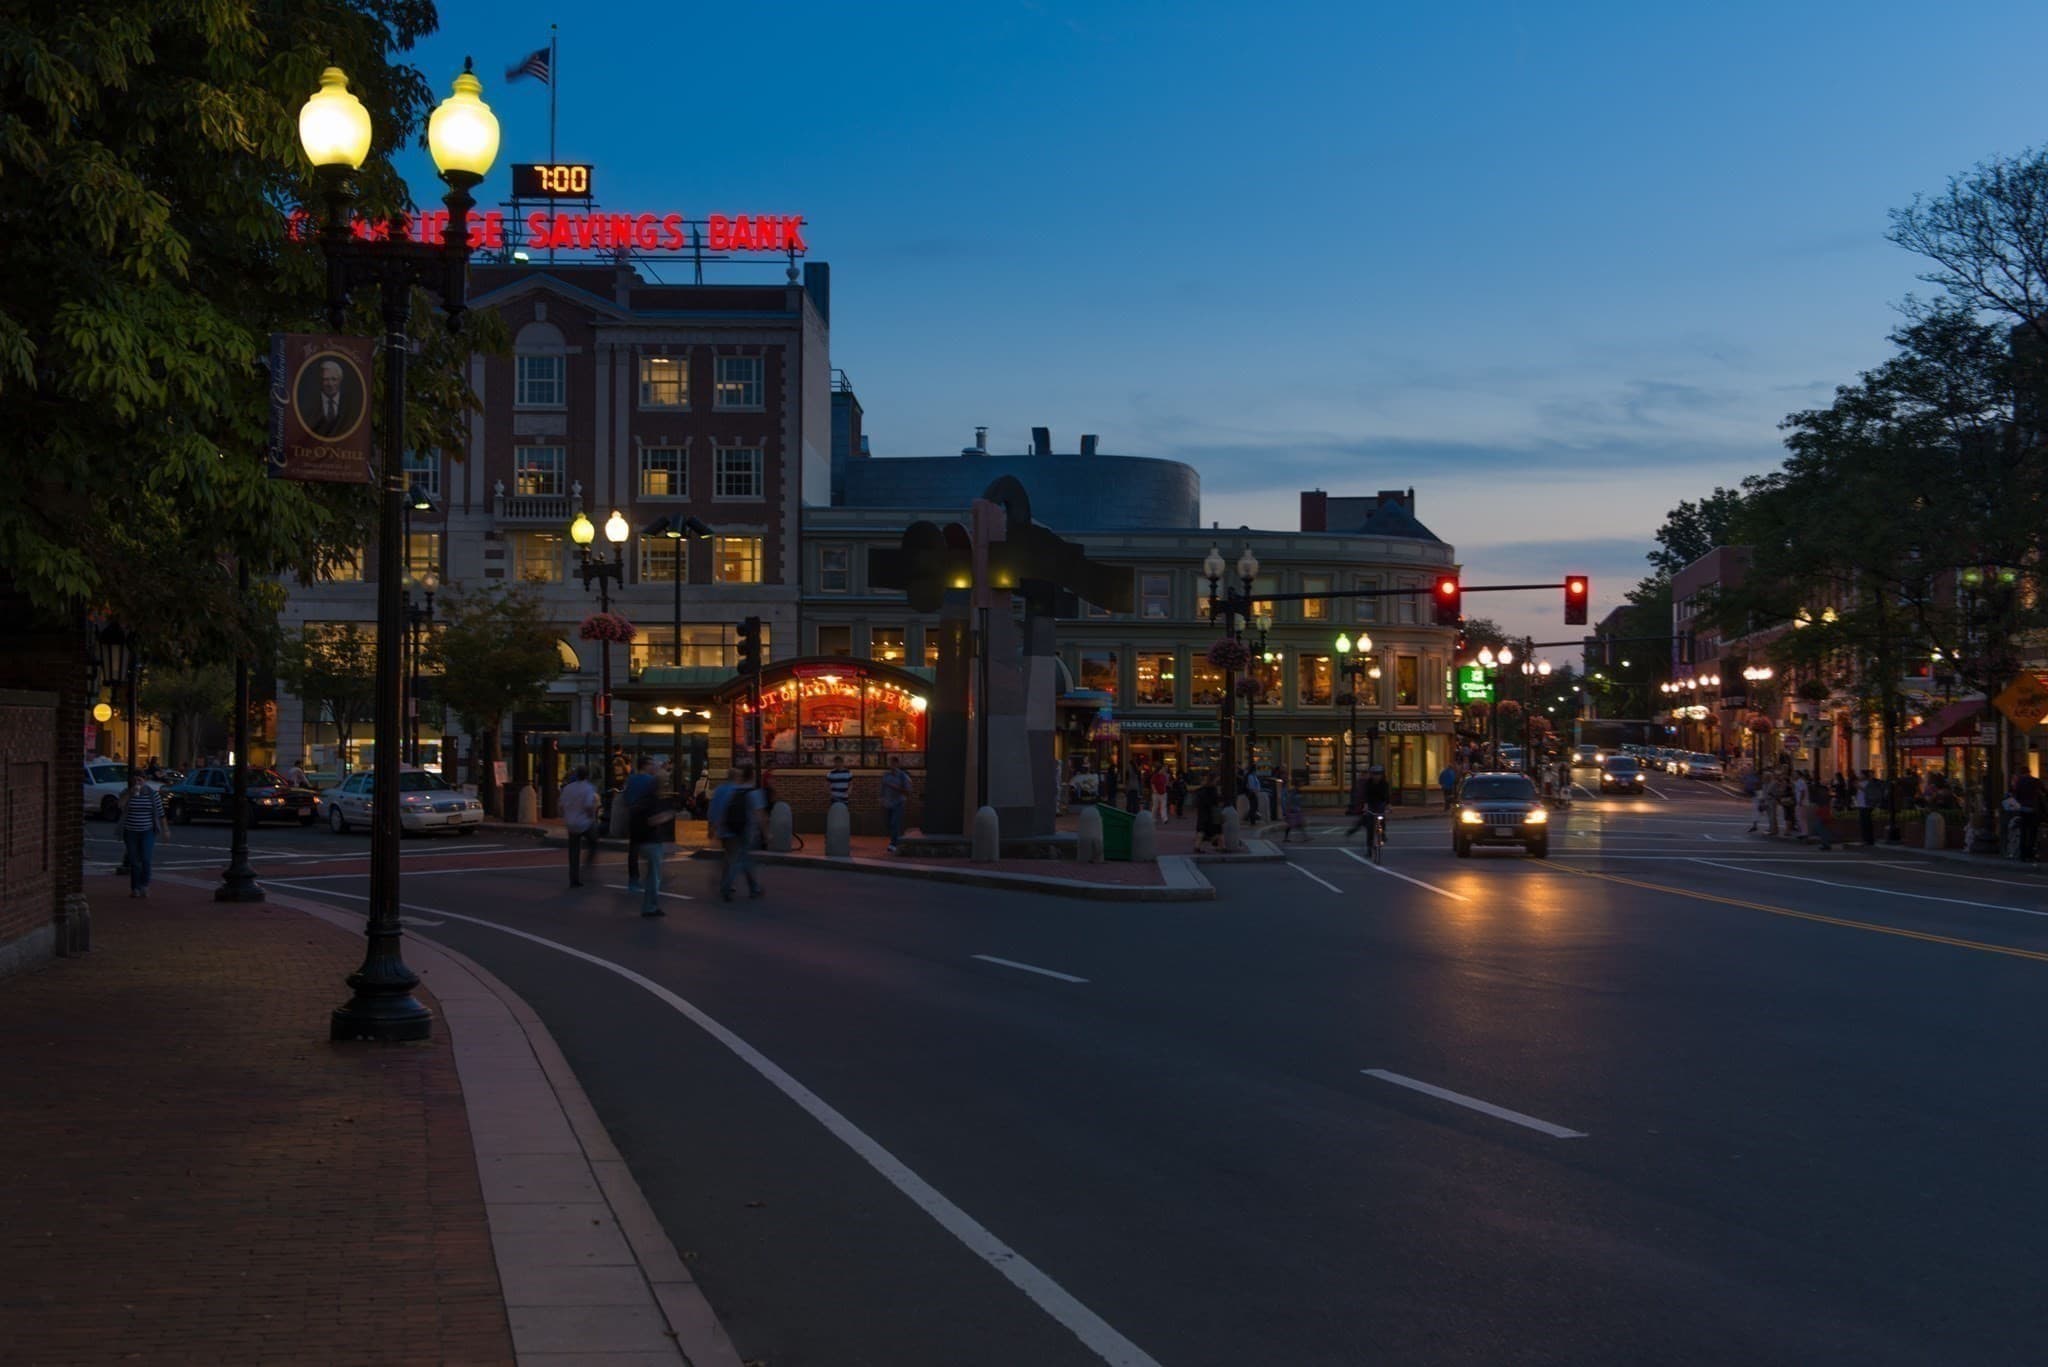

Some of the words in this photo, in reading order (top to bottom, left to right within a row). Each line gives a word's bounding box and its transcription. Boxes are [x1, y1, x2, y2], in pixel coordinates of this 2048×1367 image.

[534, 165, 588, 193] 7:00
[528, 213, 684, 250] SAVINGS
[709, 215, 807, 251] BANK
[1164, 720, 1194, 729] COFFEE
[1389, 720, 1420, 732] Citizens
